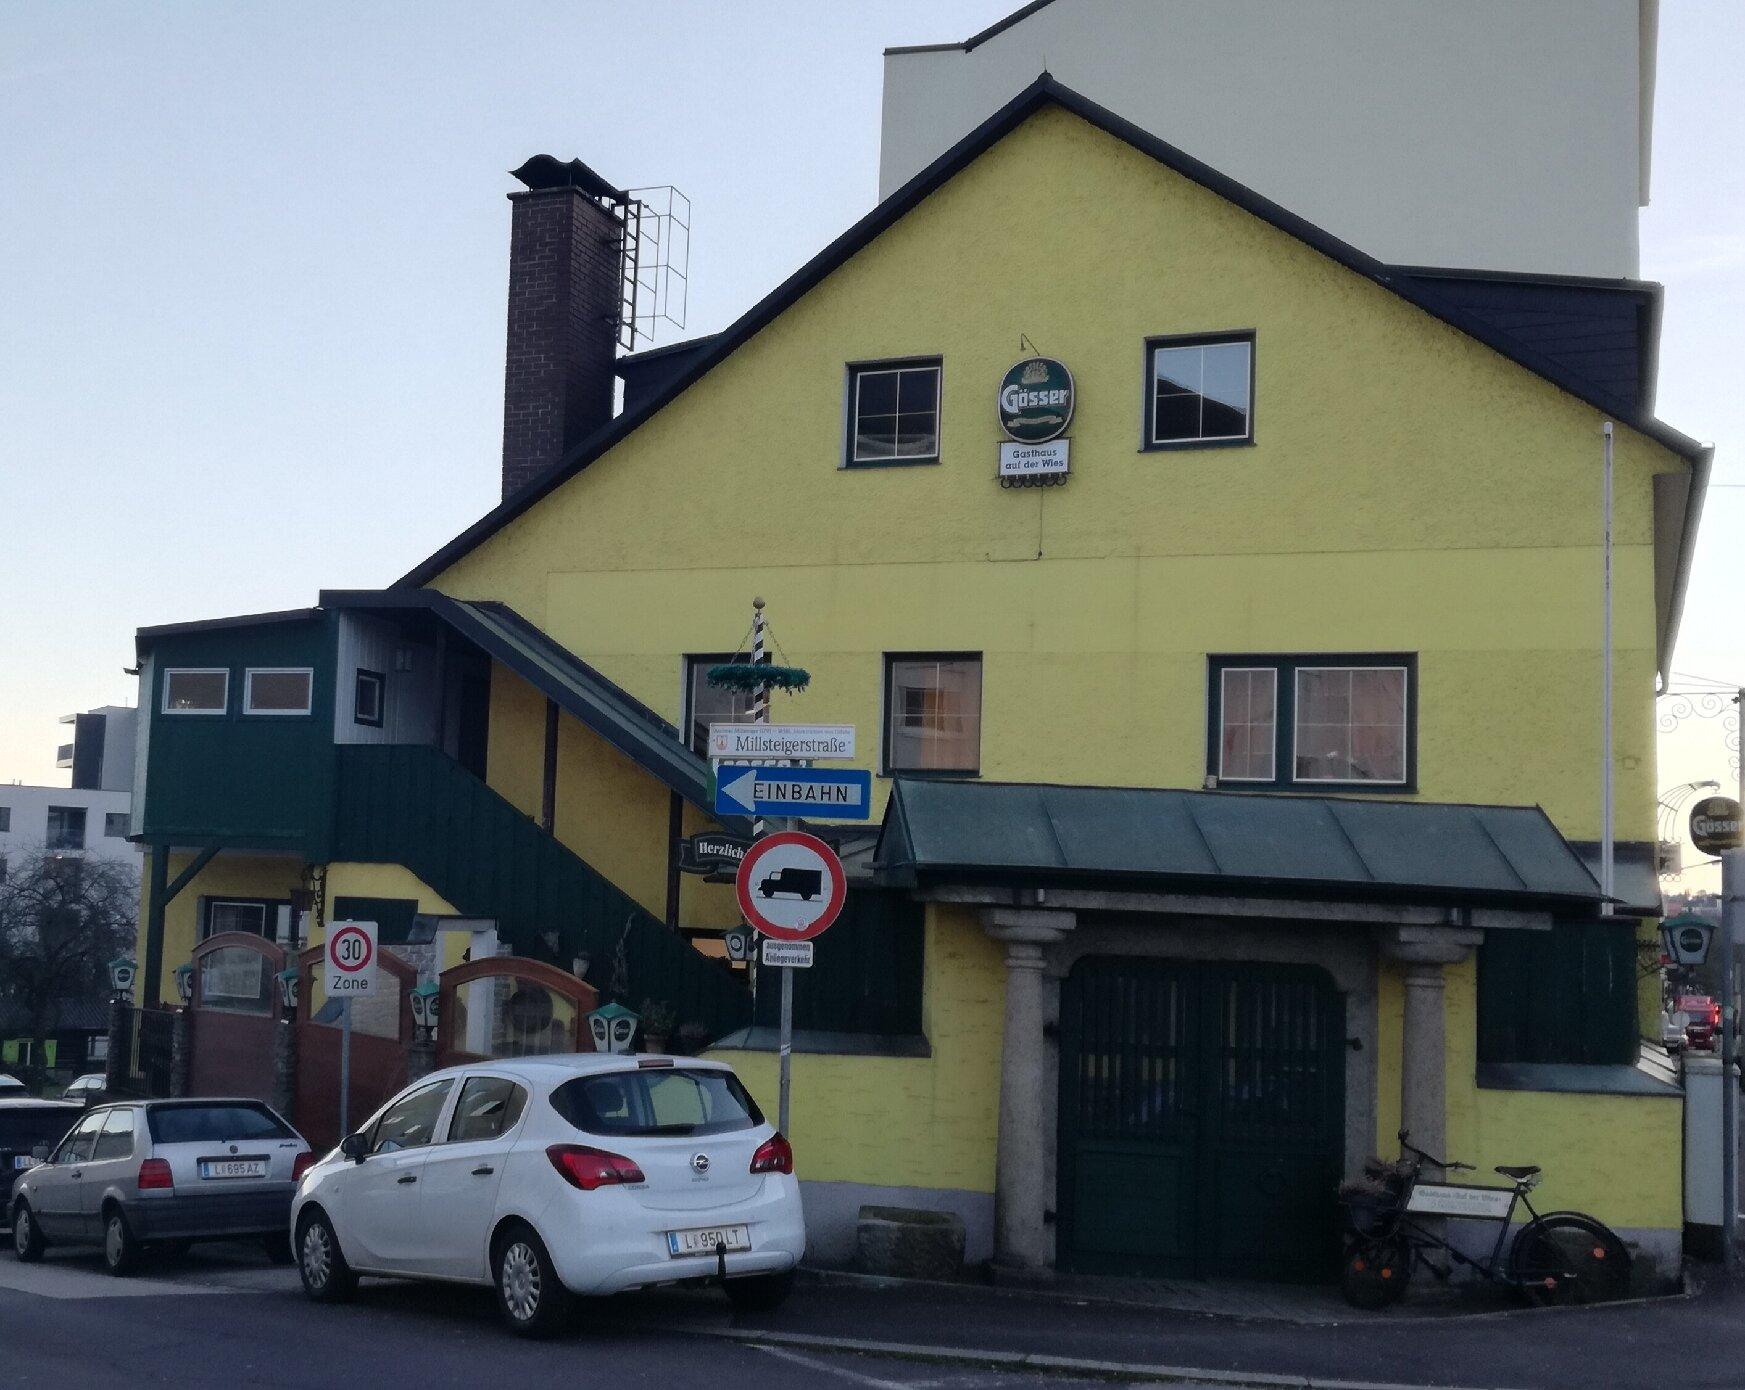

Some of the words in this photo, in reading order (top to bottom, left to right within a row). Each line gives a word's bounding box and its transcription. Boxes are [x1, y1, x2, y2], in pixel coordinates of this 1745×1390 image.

[1001, 384, 1069, 414] Gösser
[1012, 448, 1058, 459] Gasthaus
[1005, 460, 1021, 470] auf
[1023, 459, 1039, 469] der
[1042, 458, 1064, 468] Wies
[735, 736, 847, 756] Millsteigerstraße
[754, 782, 848, 803] EINBAHN
[699, 841, 745, 859] Herzlich
[342, 939, 361, 960] 30
[333, 976, 368, 989] Zone
